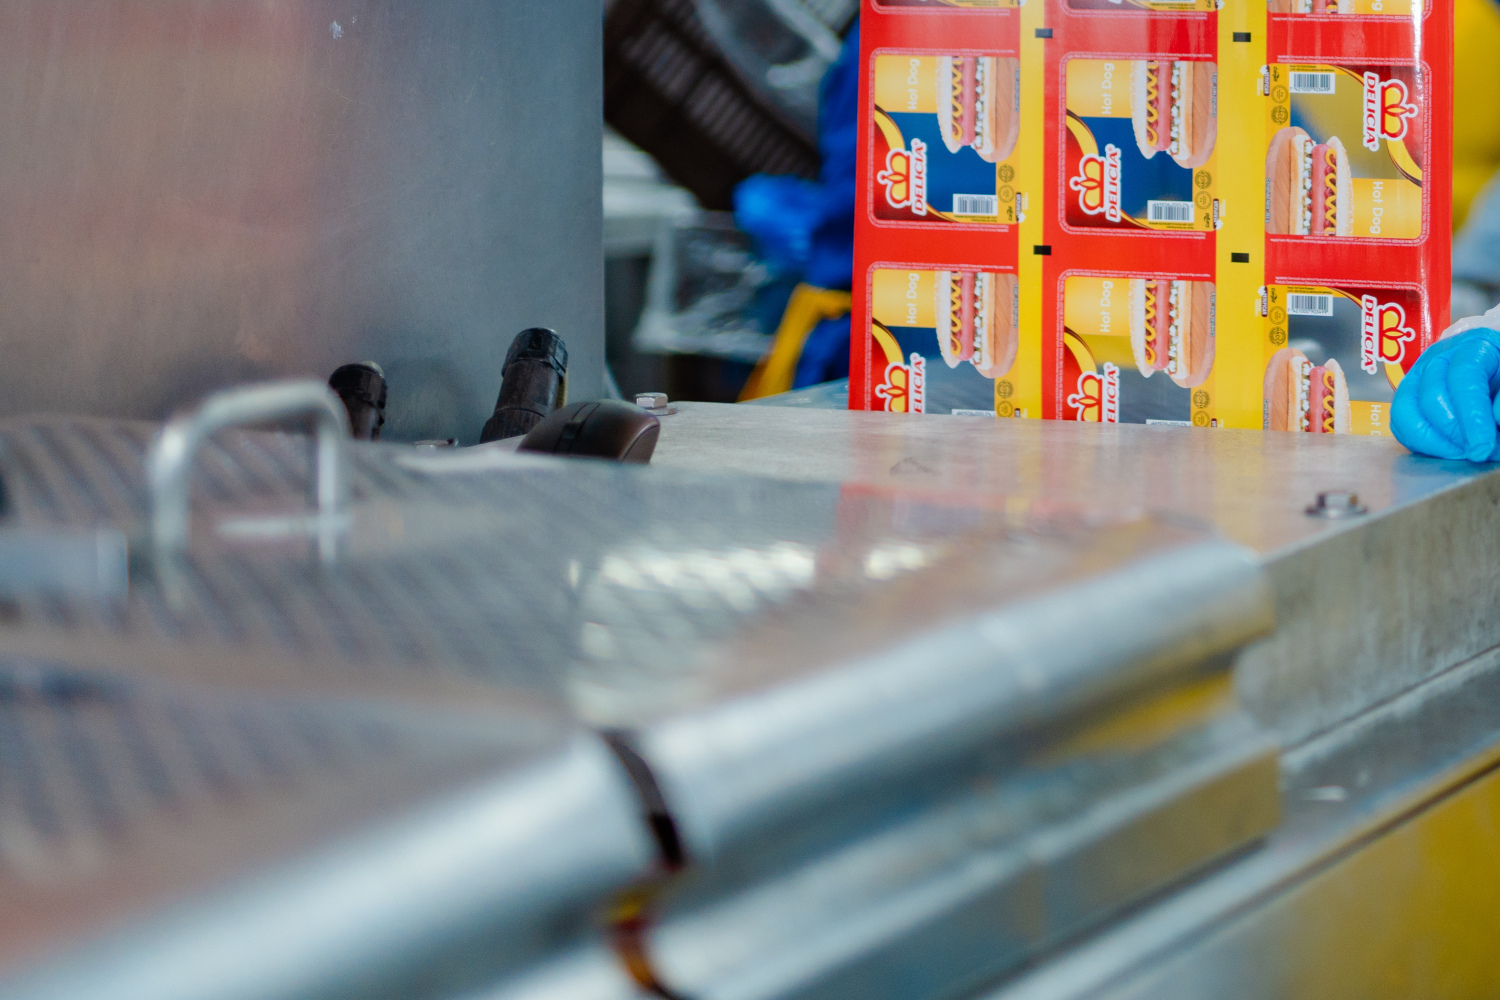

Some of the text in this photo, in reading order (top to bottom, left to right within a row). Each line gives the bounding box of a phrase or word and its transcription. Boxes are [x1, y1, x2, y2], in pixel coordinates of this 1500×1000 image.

[908, 59, 920, 109] Hot Dog
[1101, 63, 1115, 115] Hot Dog
[1369, 181, 1383, 234] Hot Dog
[906, 273, 919, 324] Hot Dog
[1101, 281, 1113, 333] Hot Dog
[1371, 404, 1381, 426] Hot
